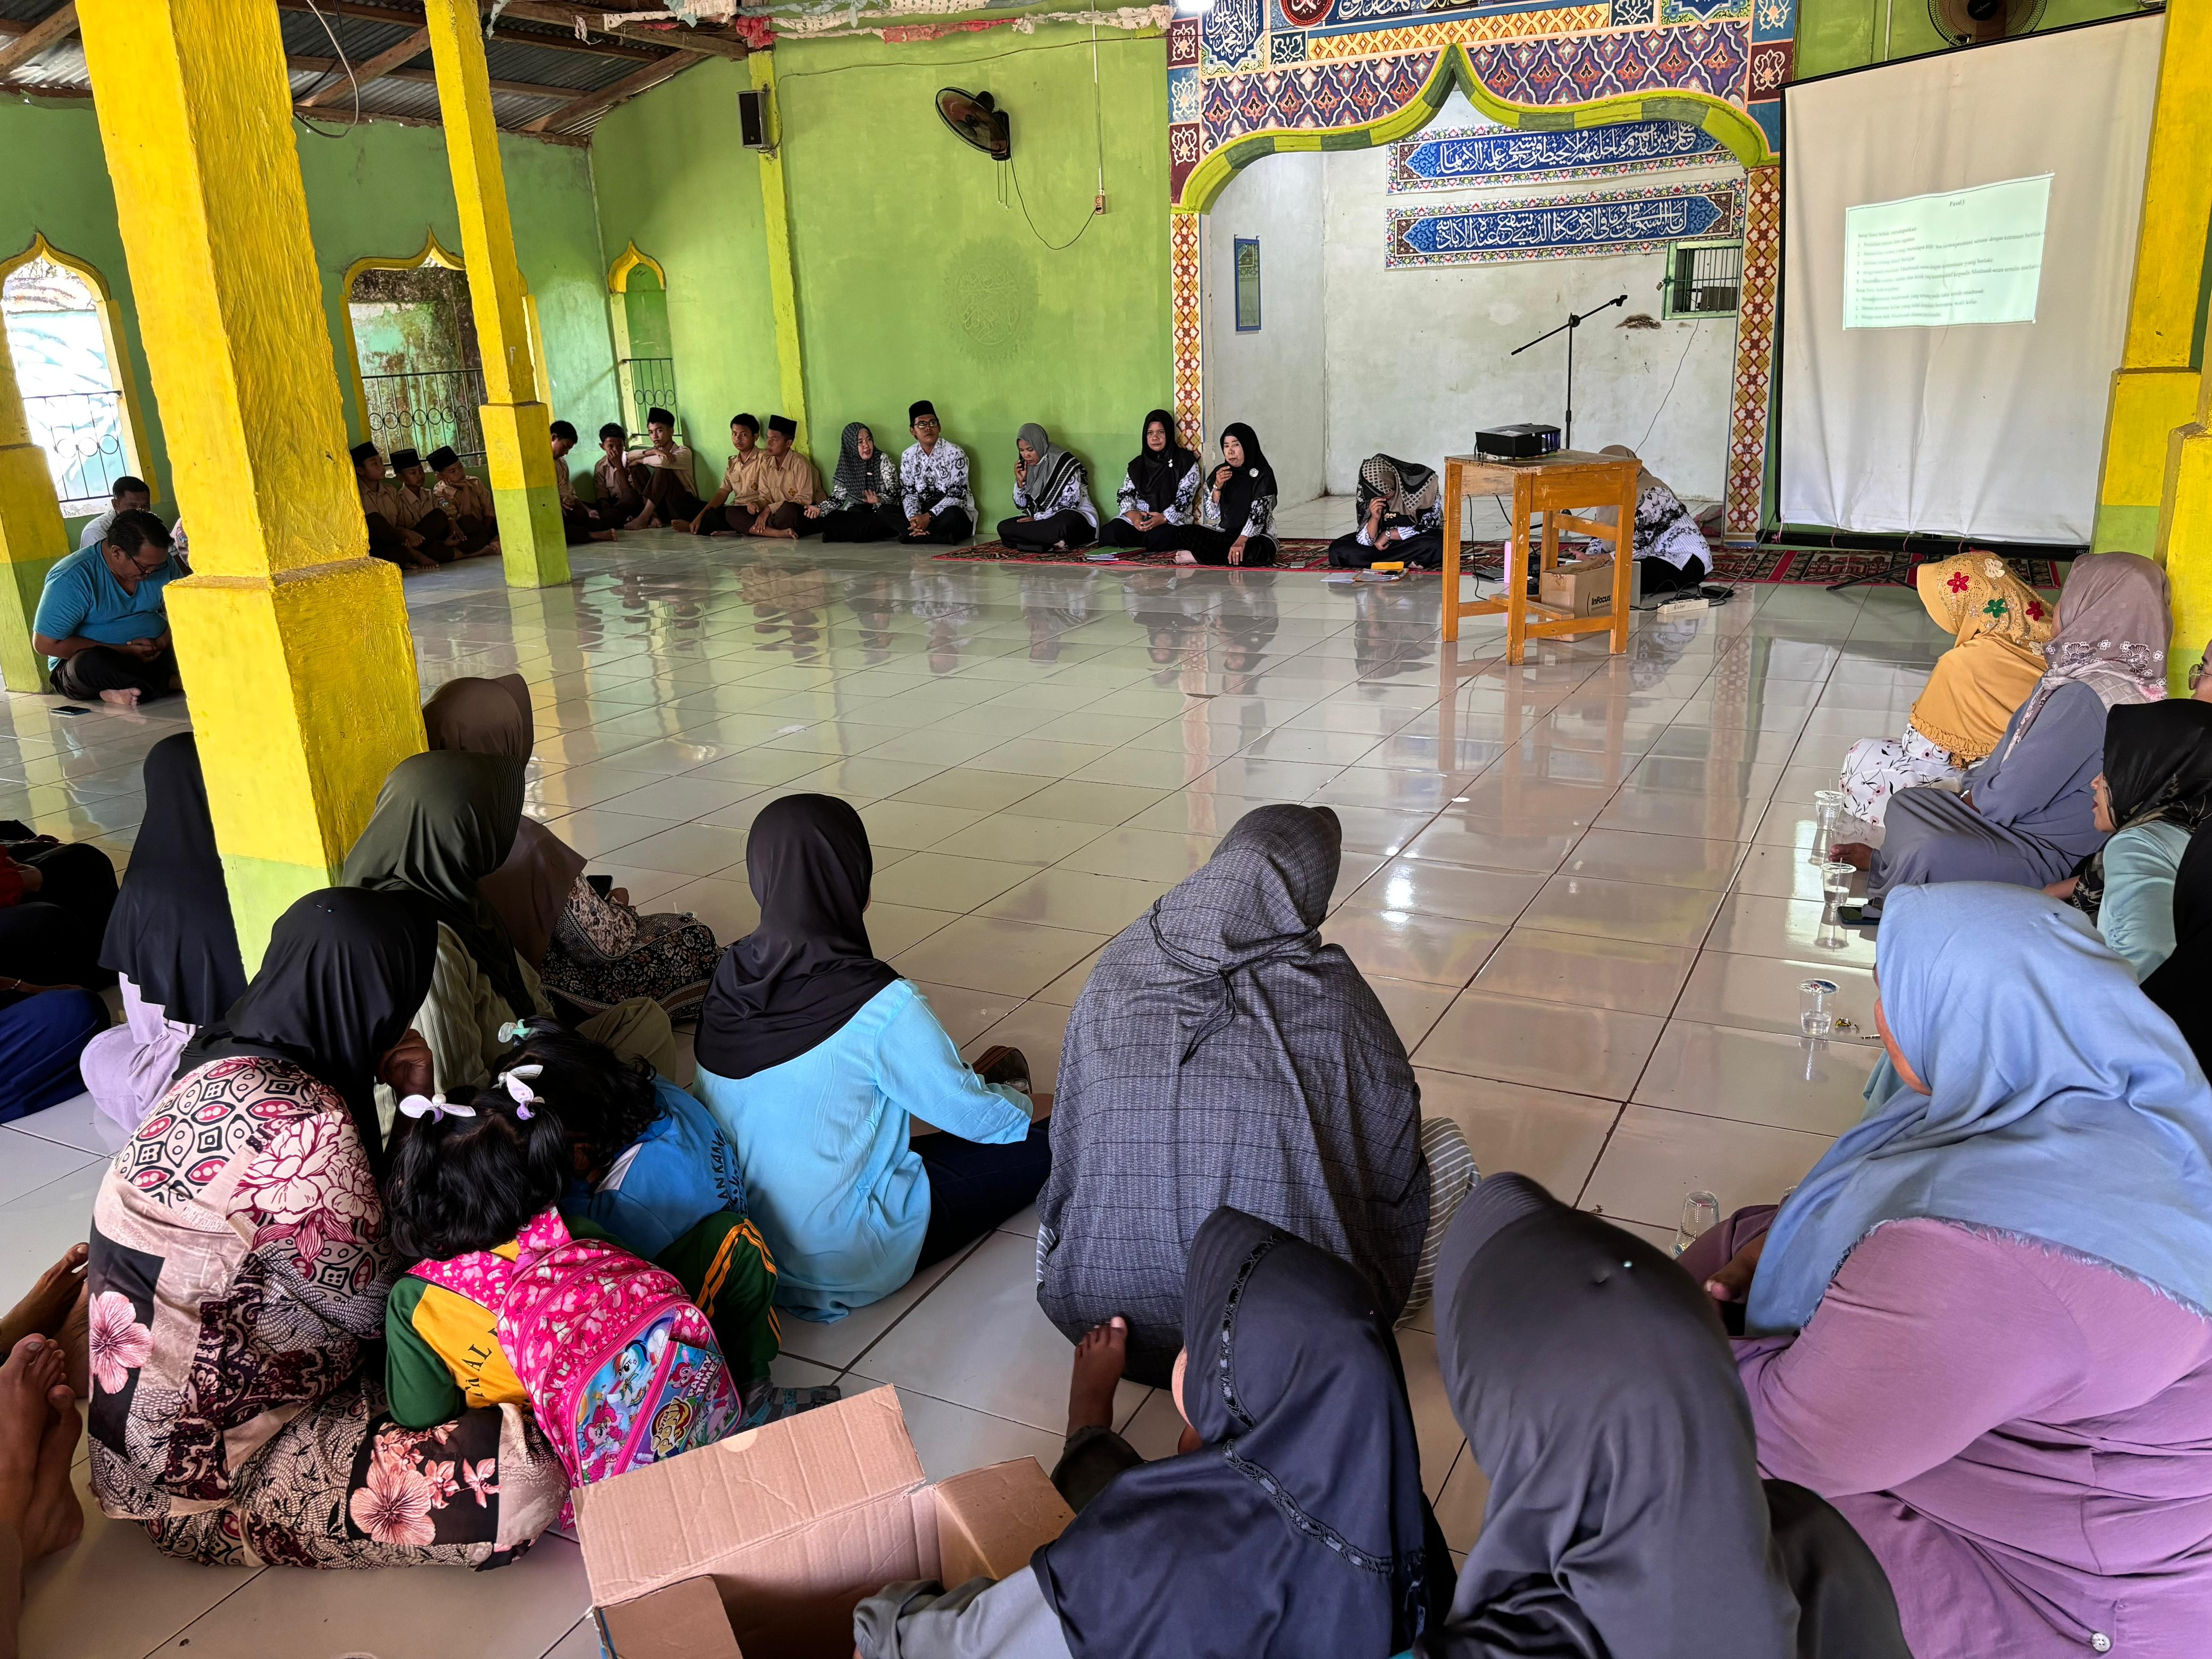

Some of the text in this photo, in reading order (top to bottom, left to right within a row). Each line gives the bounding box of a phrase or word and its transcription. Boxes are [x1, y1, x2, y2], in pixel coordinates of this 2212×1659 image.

[1591, 595, 1611, 606] InFocus
[687, 1354, 711, 1398] PARTY
[697, 1361, 718, 1397] TIME
